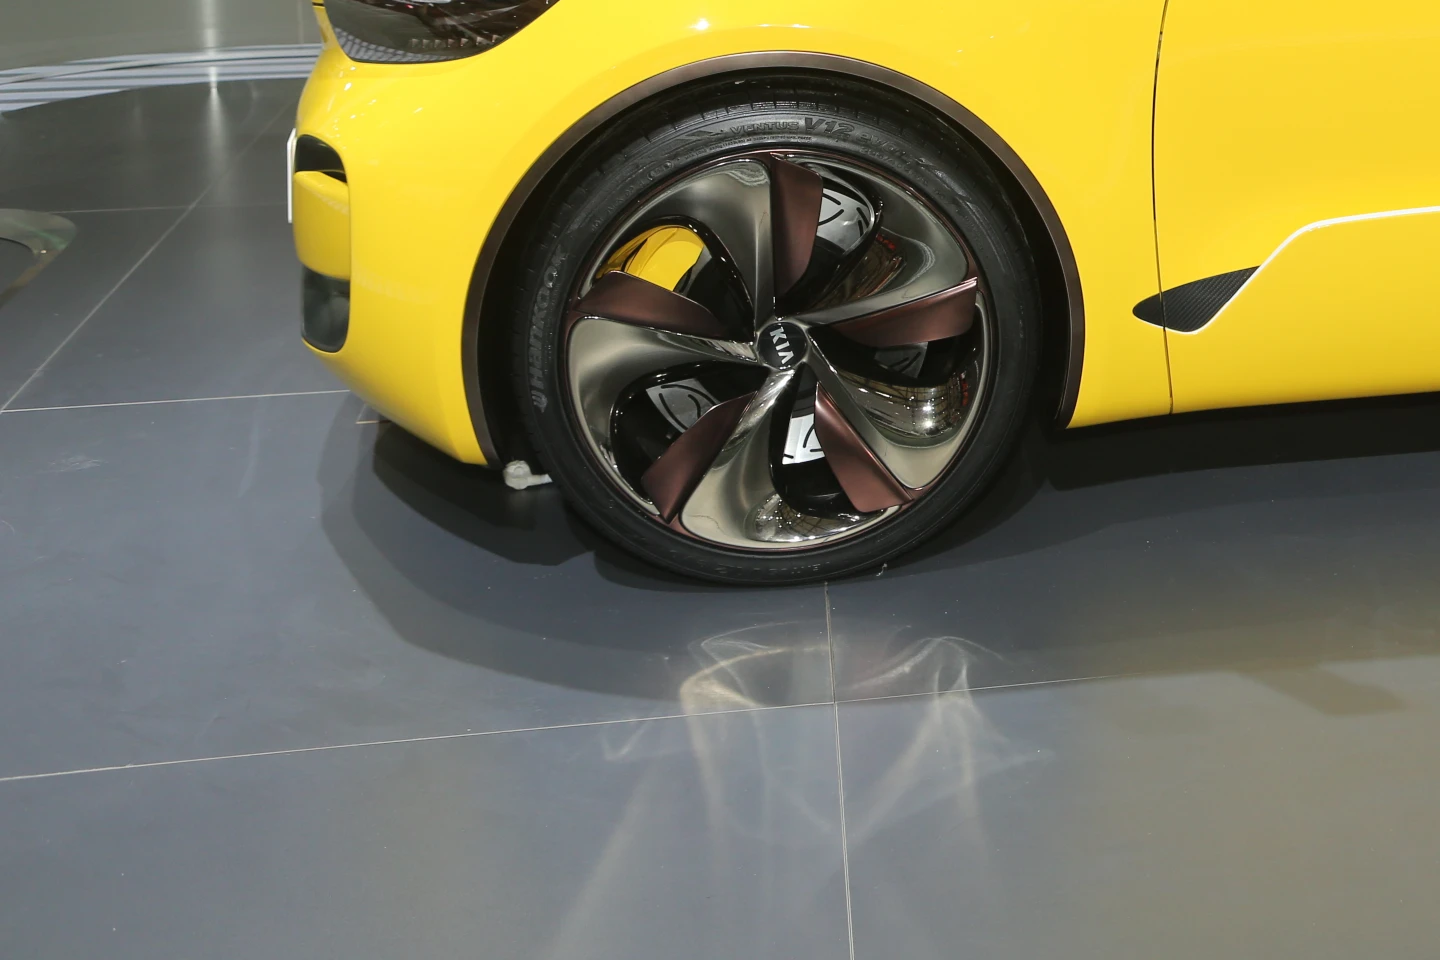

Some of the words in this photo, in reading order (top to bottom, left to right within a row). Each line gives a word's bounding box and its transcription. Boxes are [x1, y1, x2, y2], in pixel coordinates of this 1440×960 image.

[730, 120, 800, 135] VENTUS
[804, 117, 855, 141] V12
[769, 326, 794, 365] KIA
